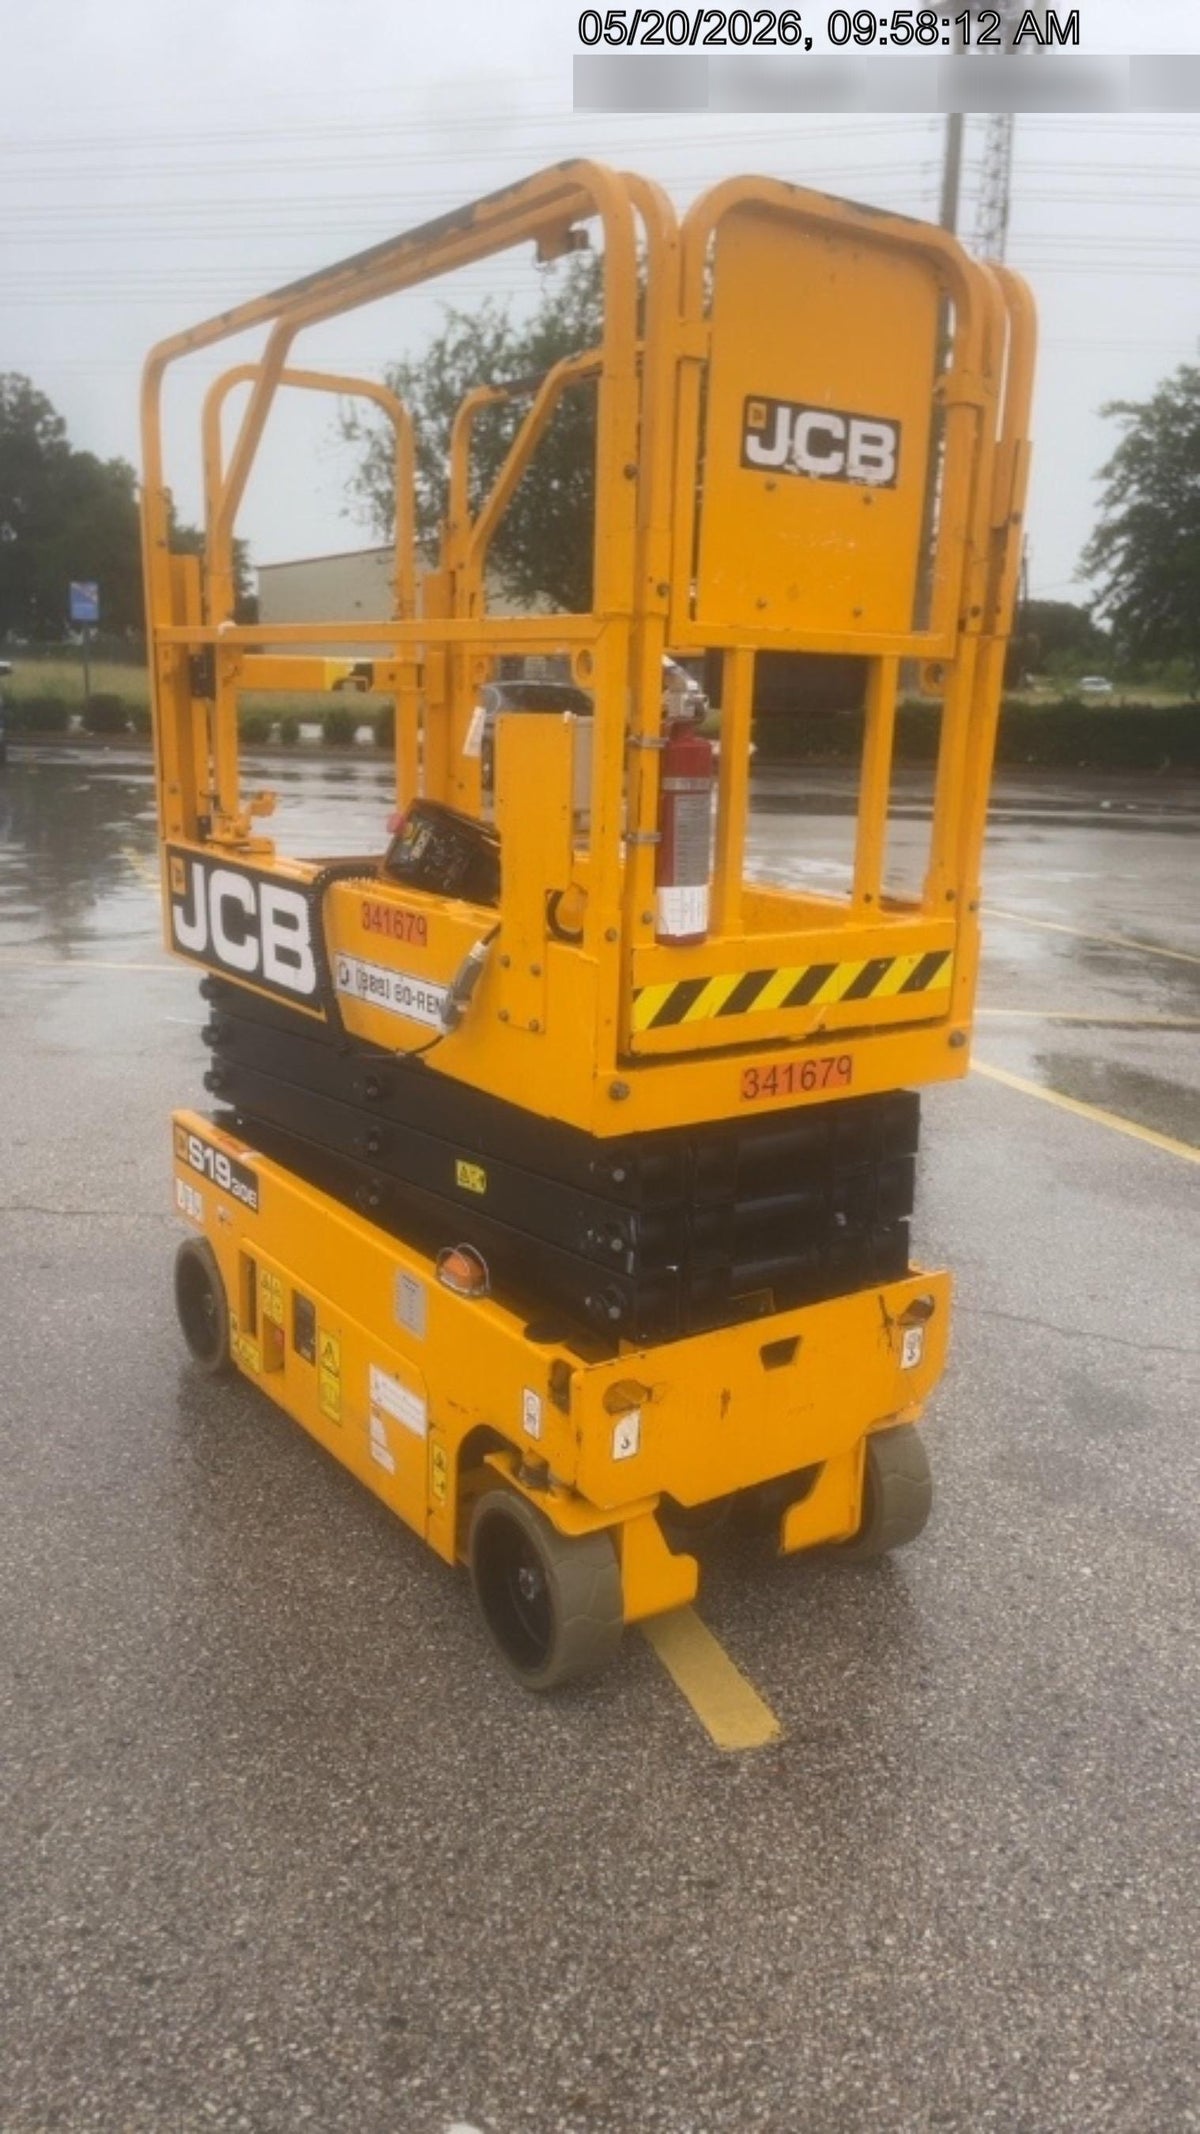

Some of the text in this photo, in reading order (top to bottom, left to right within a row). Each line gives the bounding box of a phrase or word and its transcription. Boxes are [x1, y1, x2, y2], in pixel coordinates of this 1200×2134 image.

[746, 406, 896, 486] JCB
[173, 862, 316, 995] JCB
[362, 901, 428, 946] 341679
[743, 1055, 852, 1099] 341679
